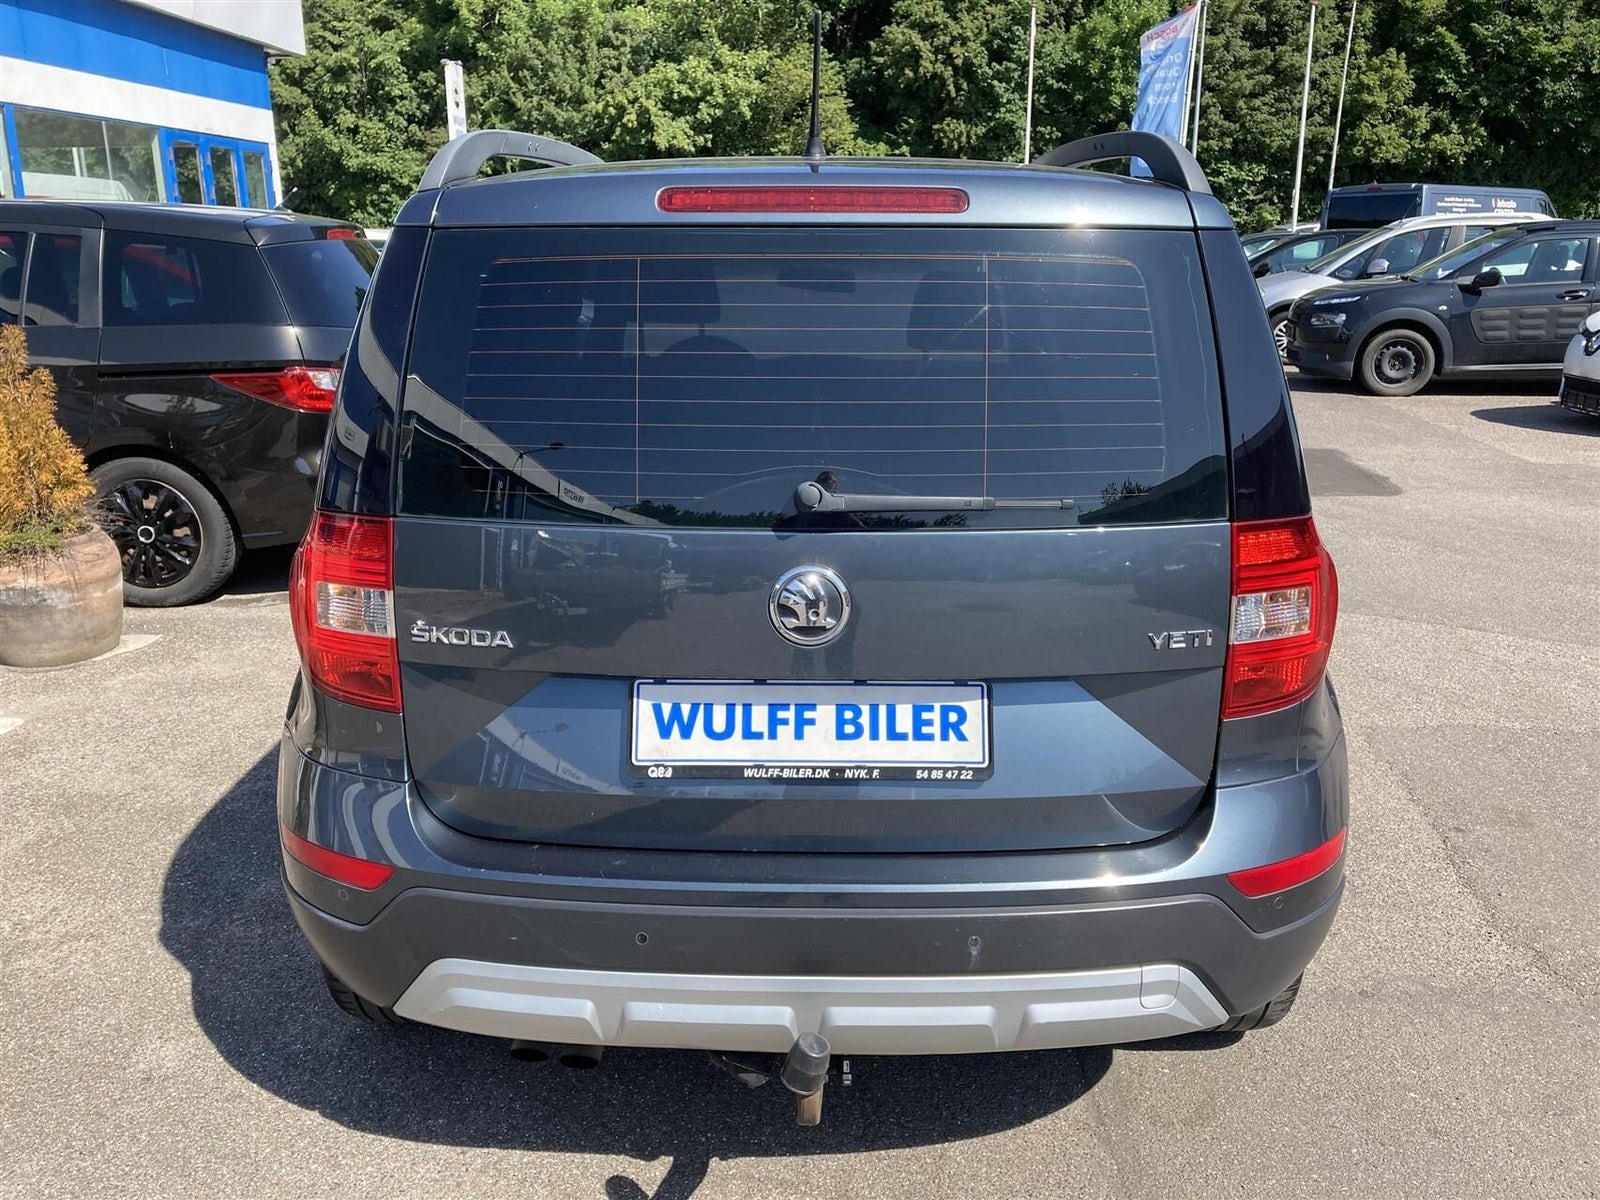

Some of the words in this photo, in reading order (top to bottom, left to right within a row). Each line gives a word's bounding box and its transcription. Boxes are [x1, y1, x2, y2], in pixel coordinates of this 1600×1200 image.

[410, 619, 514, 649] ŠKODA
[1147, 629, 1214, 651] YETI
[651, 702, 818, 741] WULFF
[834, 703, 969, 743] BILER
[743, 767, 831, 779] WULFF-BILER.DK
[844, 768, 870, 779] NYK.
[915, 769, 930, 779] 54
[930, 770, 944, 779] 85
[945, 770, 958, 779] 47
[959, 770, 974, 779] 22
